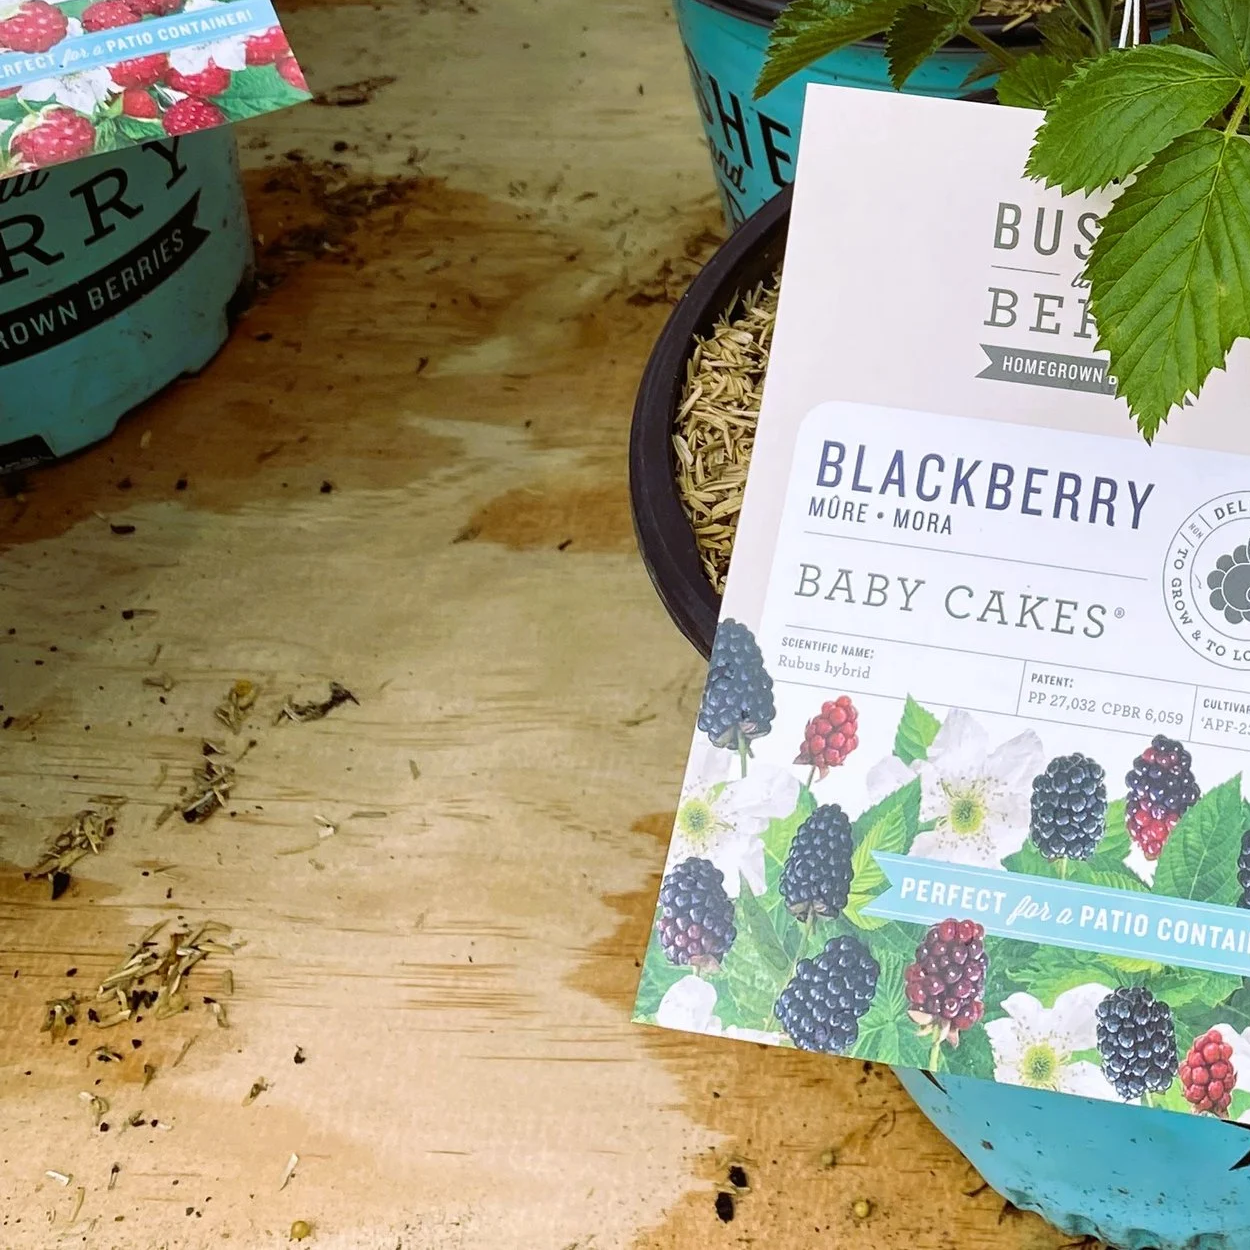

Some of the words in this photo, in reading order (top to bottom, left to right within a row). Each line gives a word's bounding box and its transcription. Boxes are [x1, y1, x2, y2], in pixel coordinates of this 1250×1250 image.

[62, 48, 90, 67] for
[106, 32, 153, 53] PATIO
[157, 9, 253, 42] CONTAINER!
[993, 201, 1102, 261] BUS
[87, 228, 184, 311] BERRIES
[1002, 355, 1103, 384] HOMEGROWN
[815, 439, 1156, 531] BLACKBERRY
[808, 495, 869, 524] MÛRE
[893, 508, 953, 535] MORA
[1173, 548, 1189, 570] TO
[794, 563, 927, 612] BABY
[1171, 577, 1193, 626] GROW
[781, 636, 838, 654] SCIENTIFIC
[841, 644, 875, 660] NAME:
[1191, 629, 1202, 641] &
[1205, 639, 1227, 657] TO
[777, 654, 821, 672] Rubus
[824, 660, 872, 680] hybrid
[1030, 672, 1074, 688] PATENT:
[1027, 690, 1047, 705] PP
[1049, 693, 1096, 713] 27,032
[1101, 700, 1141, 719] CPBR
[1145, 707, 1184, 726] 6,059
[899, 877, 1007, 915] PERFECT
[1004, 894, 1051, 926] for
[1055, 908, 1075, 925] a
[1078, 904, 1150, 938] PATIO
